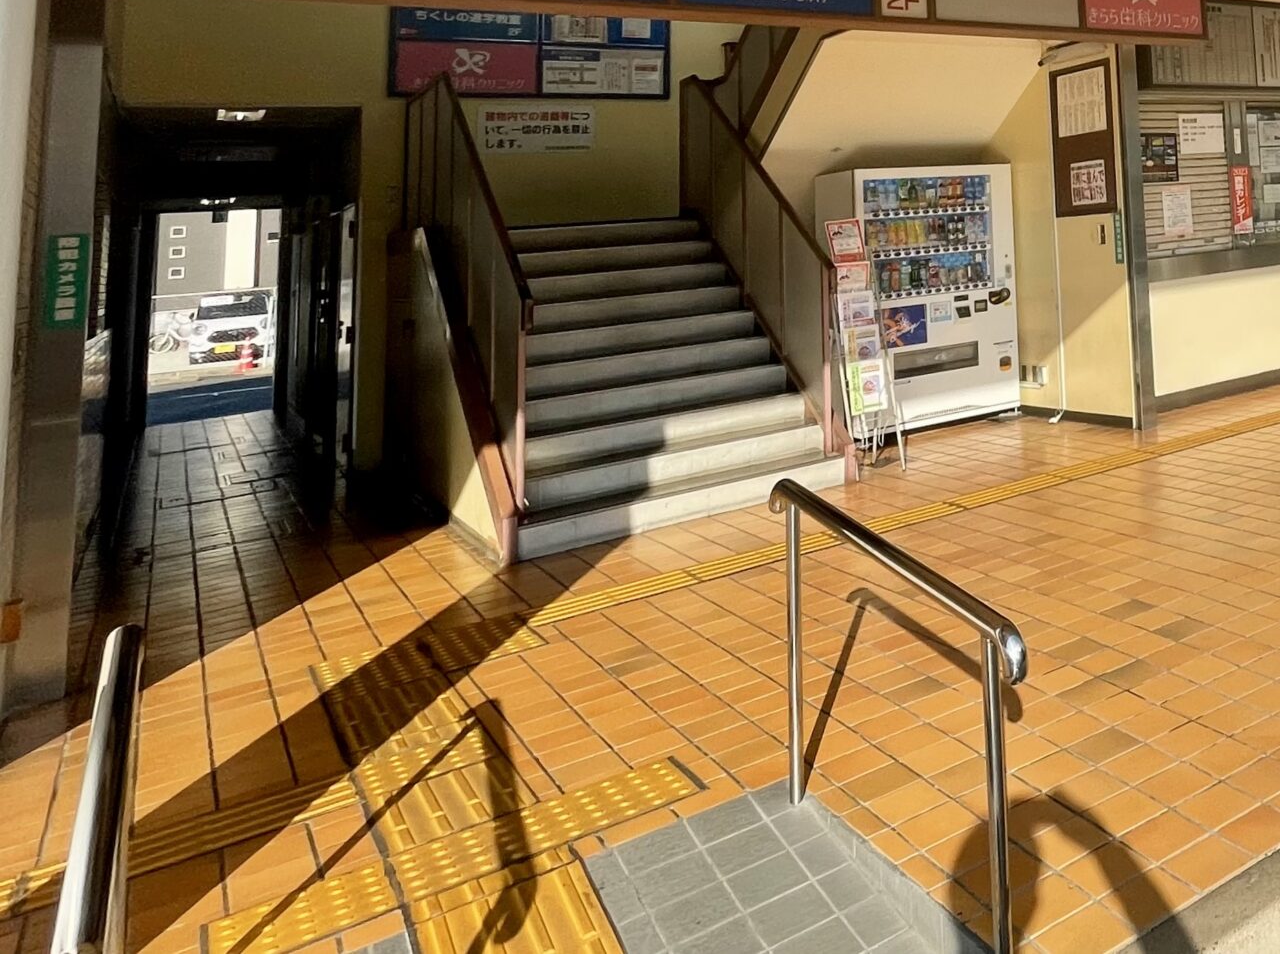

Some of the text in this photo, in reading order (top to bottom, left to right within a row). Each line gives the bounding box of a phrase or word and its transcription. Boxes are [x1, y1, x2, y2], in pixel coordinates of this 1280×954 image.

[1088, 7, 1199, 30] きらら歯科クリニック
